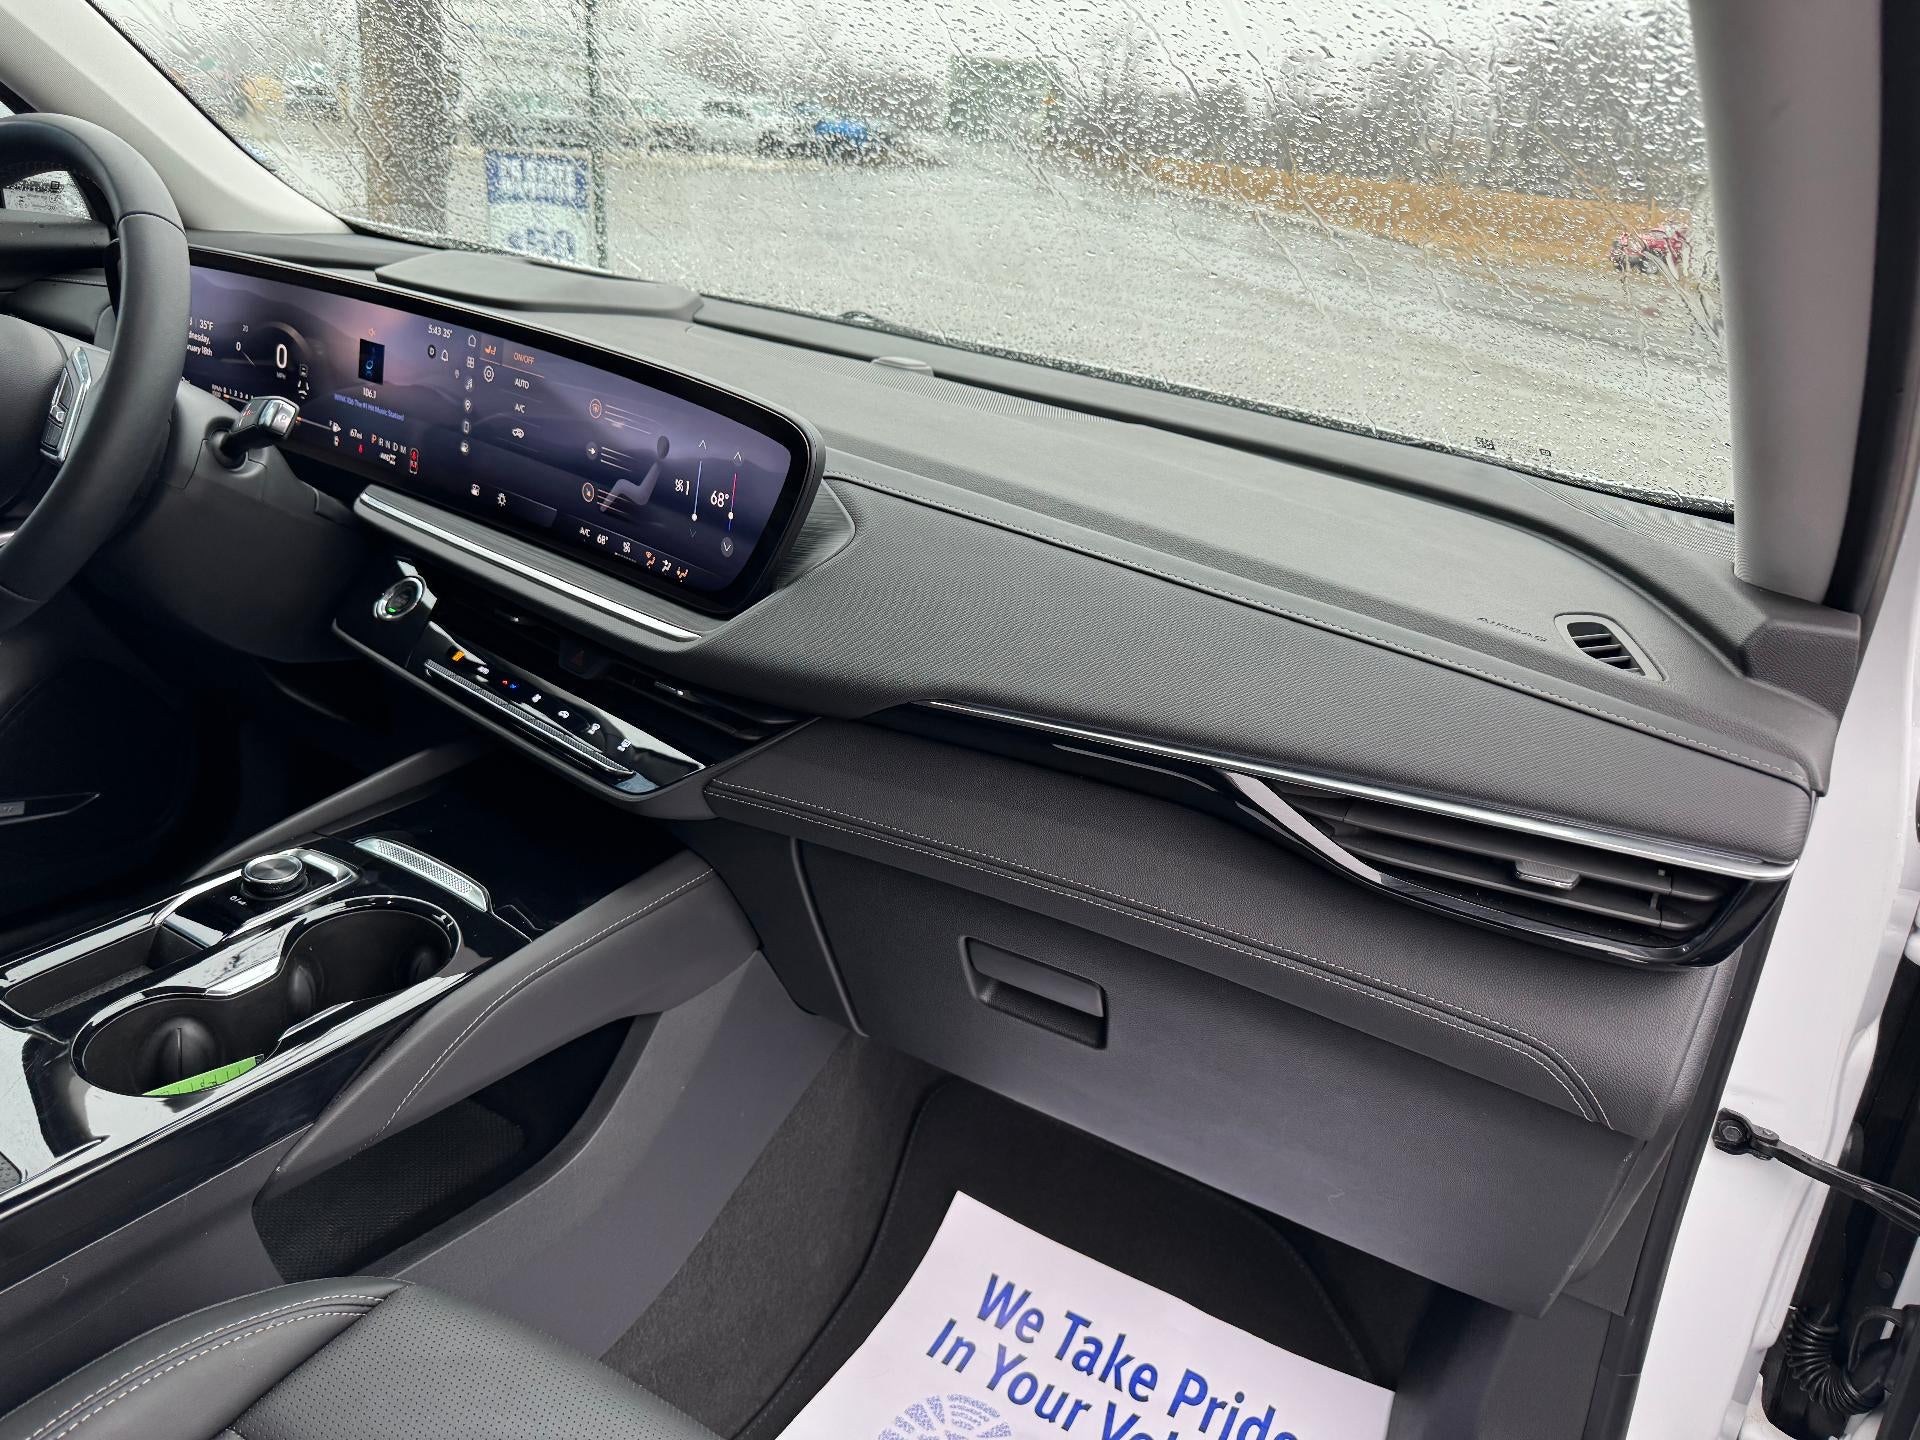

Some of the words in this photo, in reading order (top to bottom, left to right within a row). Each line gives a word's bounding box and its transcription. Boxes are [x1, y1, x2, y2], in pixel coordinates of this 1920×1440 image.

[188, 330, 211, 345] dnesday,
[235, 341, 242, 351] 0
[276, 343, 288, 369] 0
[513, 352, 535, 365] ON/OFF
[514, 378, 530, 390] AUTO
[514, 403, 526, 414] A/C
[371, 433, 377, 444] P
[393, 442, 399, 452] D
[400, 444, 407, 454] M
[710, 490, 730, 508] 68°
[579, 526, 591, 537] A/C
[977, 1273, 1045, 1344] We
[1054, 1310, 1159, 1402] Take
[926, 1318, 976, 1373] In
[986, 1343, 1093, 1431] Your
